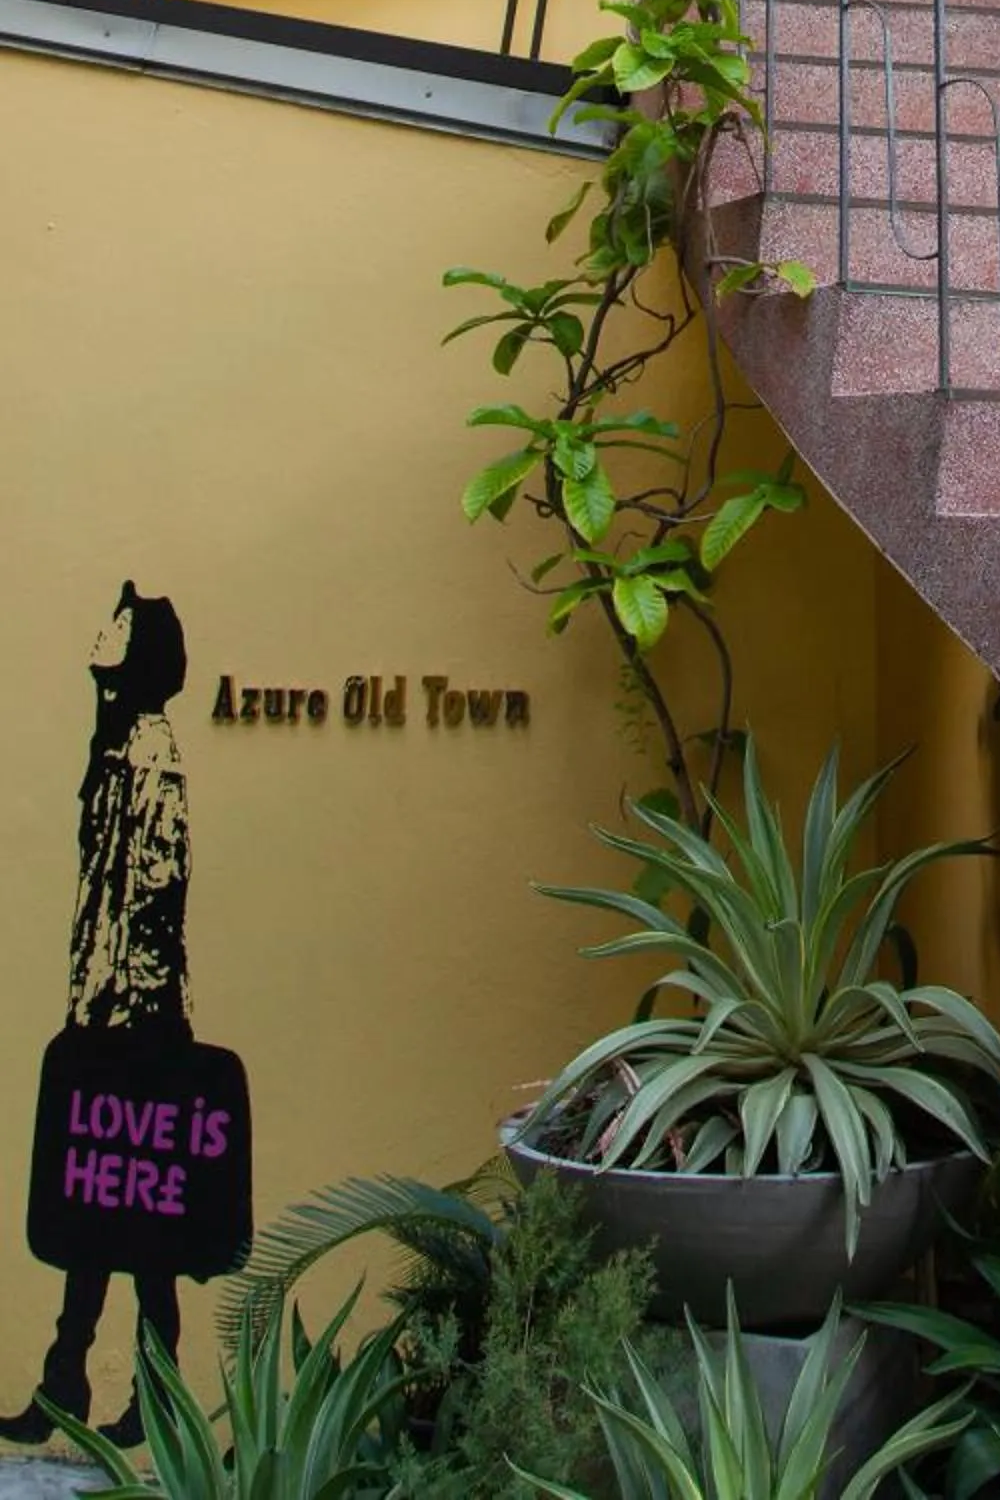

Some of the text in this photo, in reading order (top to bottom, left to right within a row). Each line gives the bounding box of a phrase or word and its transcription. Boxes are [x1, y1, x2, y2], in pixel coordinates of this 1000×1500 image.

[211, 675, 530, 728] Azure Old Town
[69, 1089, 178, 1150] LOVE
[64, 1146, 186, 1216] HERE
